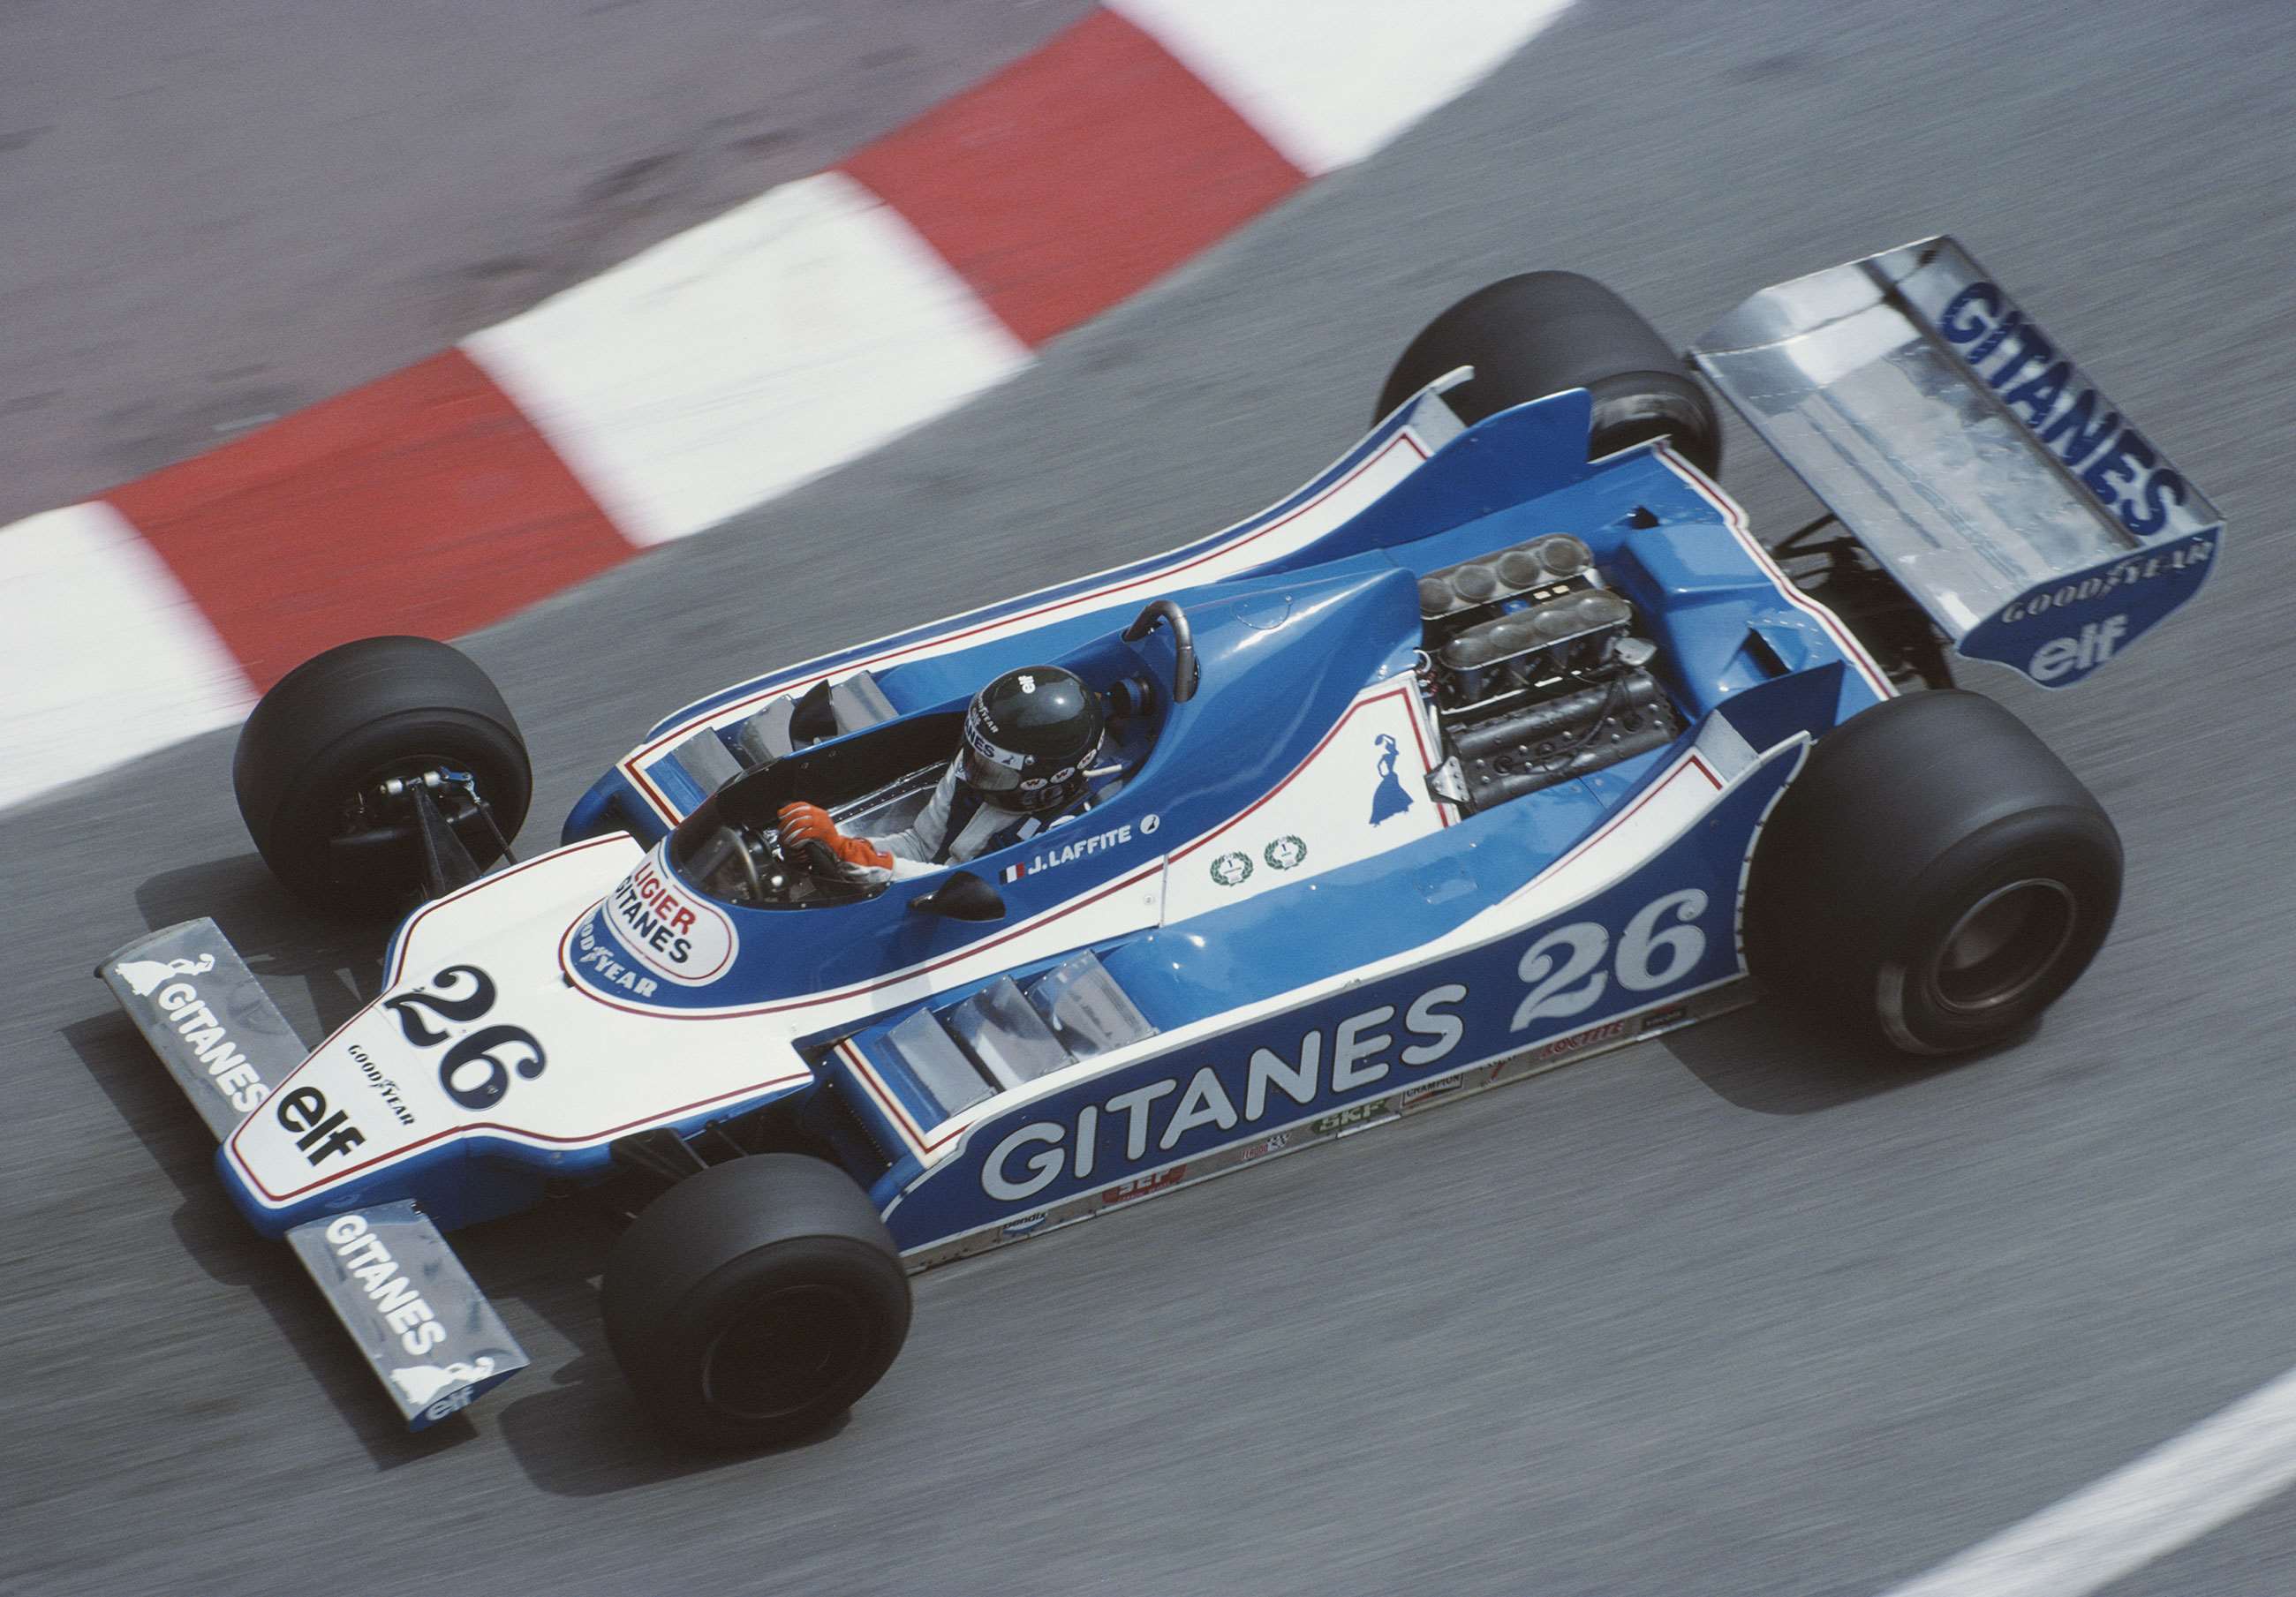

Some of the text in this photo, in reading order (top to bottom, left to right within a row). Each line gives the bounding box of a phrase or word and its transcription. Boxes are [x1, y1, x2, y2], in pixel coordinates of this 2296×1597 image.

[1941, 282, 2188, 536] GITANES
[1017, 675, 1036, 694] elf
[2028, 614, 2128, 681] elf
[1027, 824, 1132, 875] J.LAFFITE
[634, 861, 697, 936] LIGIER
[157, 982, 271, 1114] GITANES
[382, 964, 548, 1111] 26
[981, 888, 1709, 1202] GITANES 26
[276, 1086, 366, 1167] elf
[348, 1043, 416, 1127] GOODYEAR
[325, 1214, 447, 1356] GITANES
